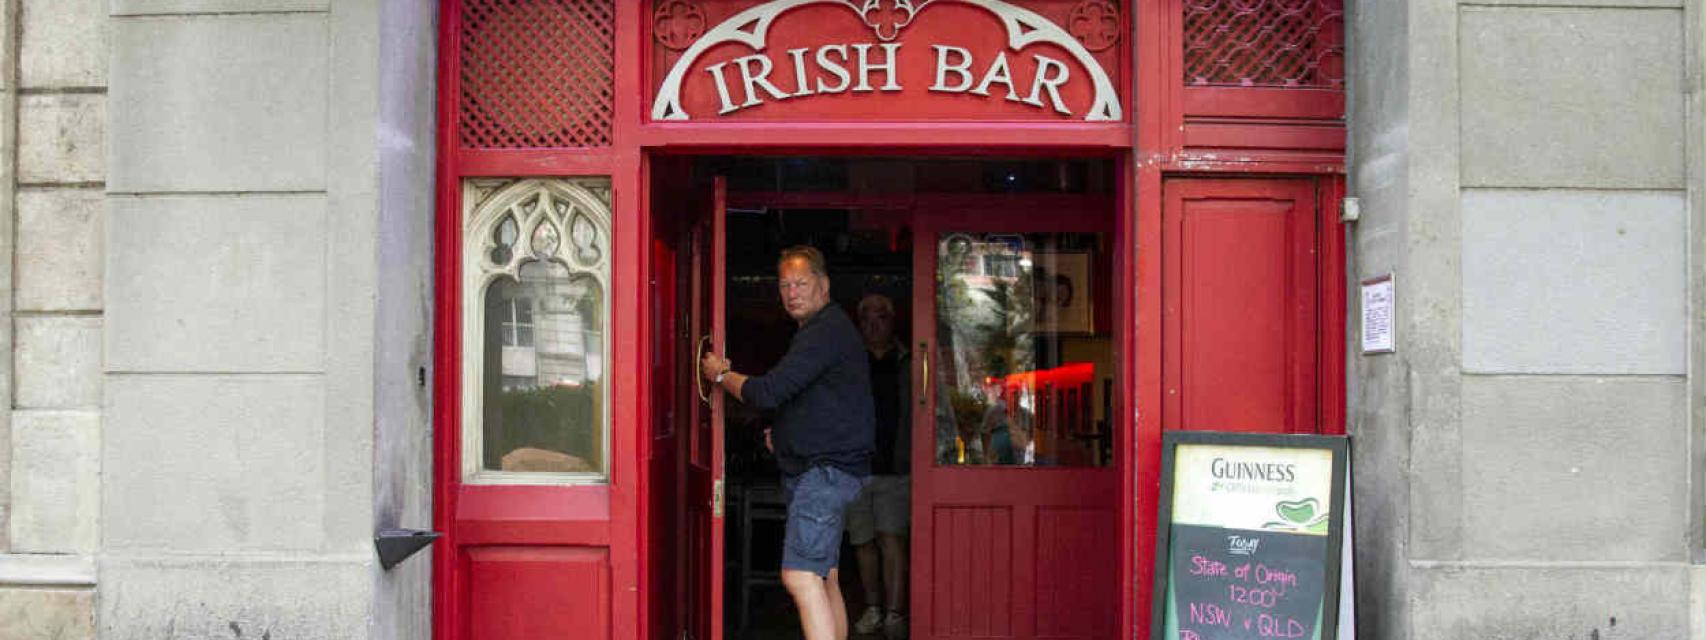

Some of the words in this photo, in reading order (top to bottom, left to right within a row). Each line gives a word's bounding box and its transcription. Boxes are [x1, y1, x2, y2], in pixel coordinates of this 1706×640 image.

[705, 43, 903, 115] IRISH
[928, 44, 1072, 115] BAR
[1211, 457, 1295, 482] GUINNESS
[1190, 555, 1228, 577] State
[1234, 563, 1251, 579] of
[1255, 564, 1298, 591] Origin
[1190, 602, 1232, 628] NSW
[1257, 613, 1305, 638] QLD
